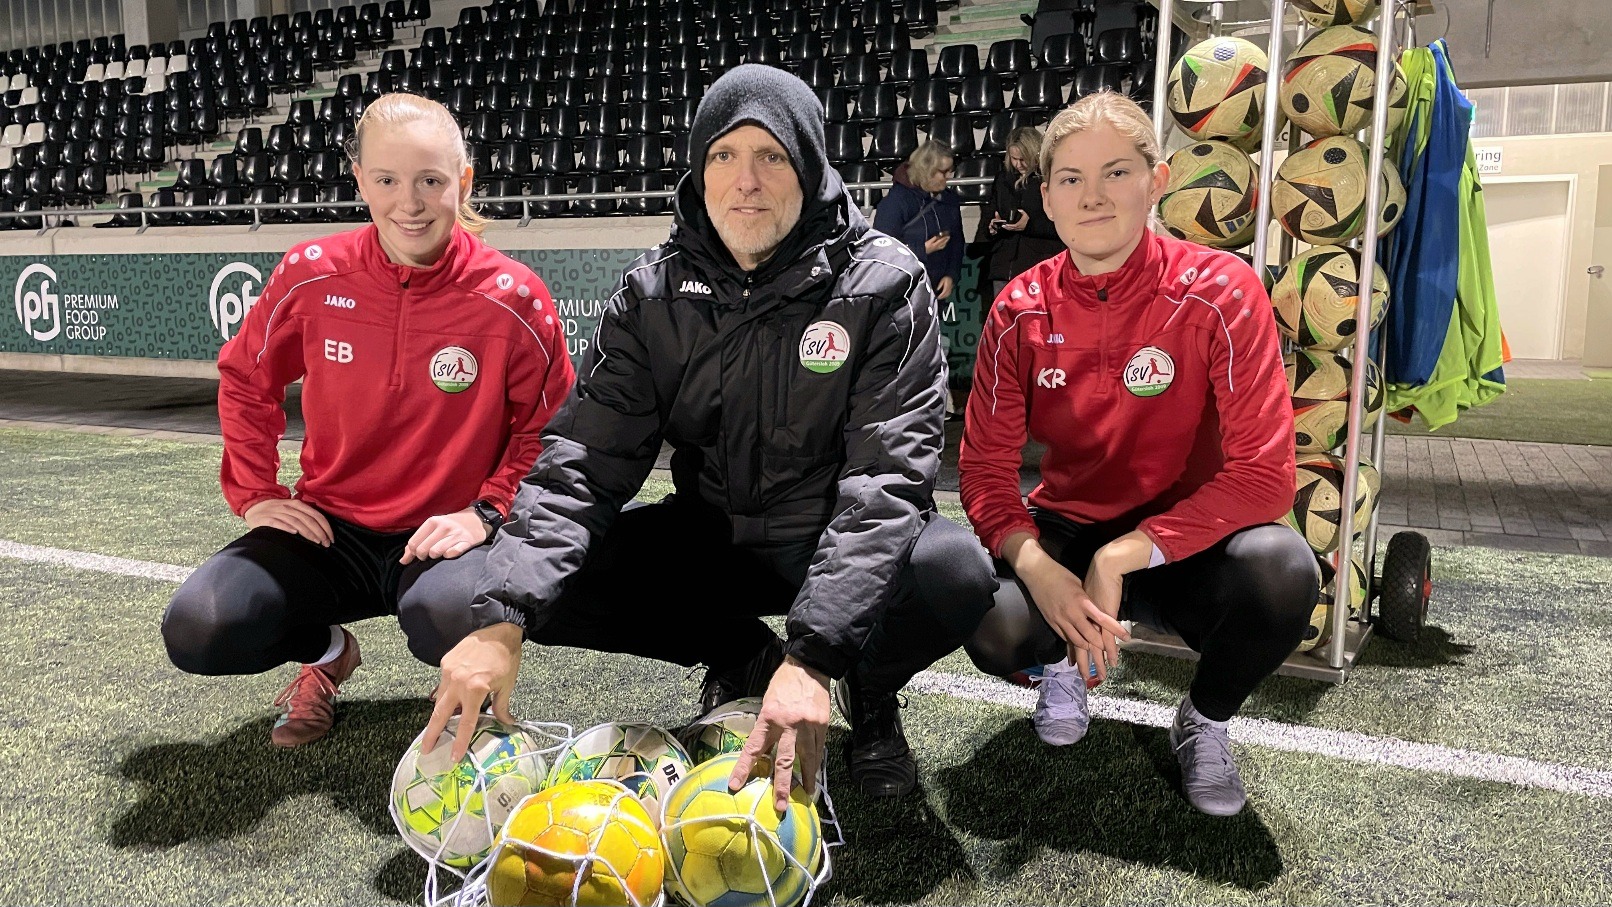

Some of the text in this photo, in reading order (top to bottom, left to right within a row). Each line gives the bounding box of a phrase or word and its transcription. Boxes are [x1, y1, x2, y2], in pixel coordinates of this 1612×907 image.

[680, 280, 712, 295] JAKO
[64, 294, 119, 309] PREMIUM
[324, 294, 356, 309] JAKO
[65, 309, 99, 324] FOOD
[66, 325, 107, 340] GROUP
[324, 338, 354, 363] EB
[801, 328, 827, 358] FSV
[1037, 367, 1067, 389] KR
